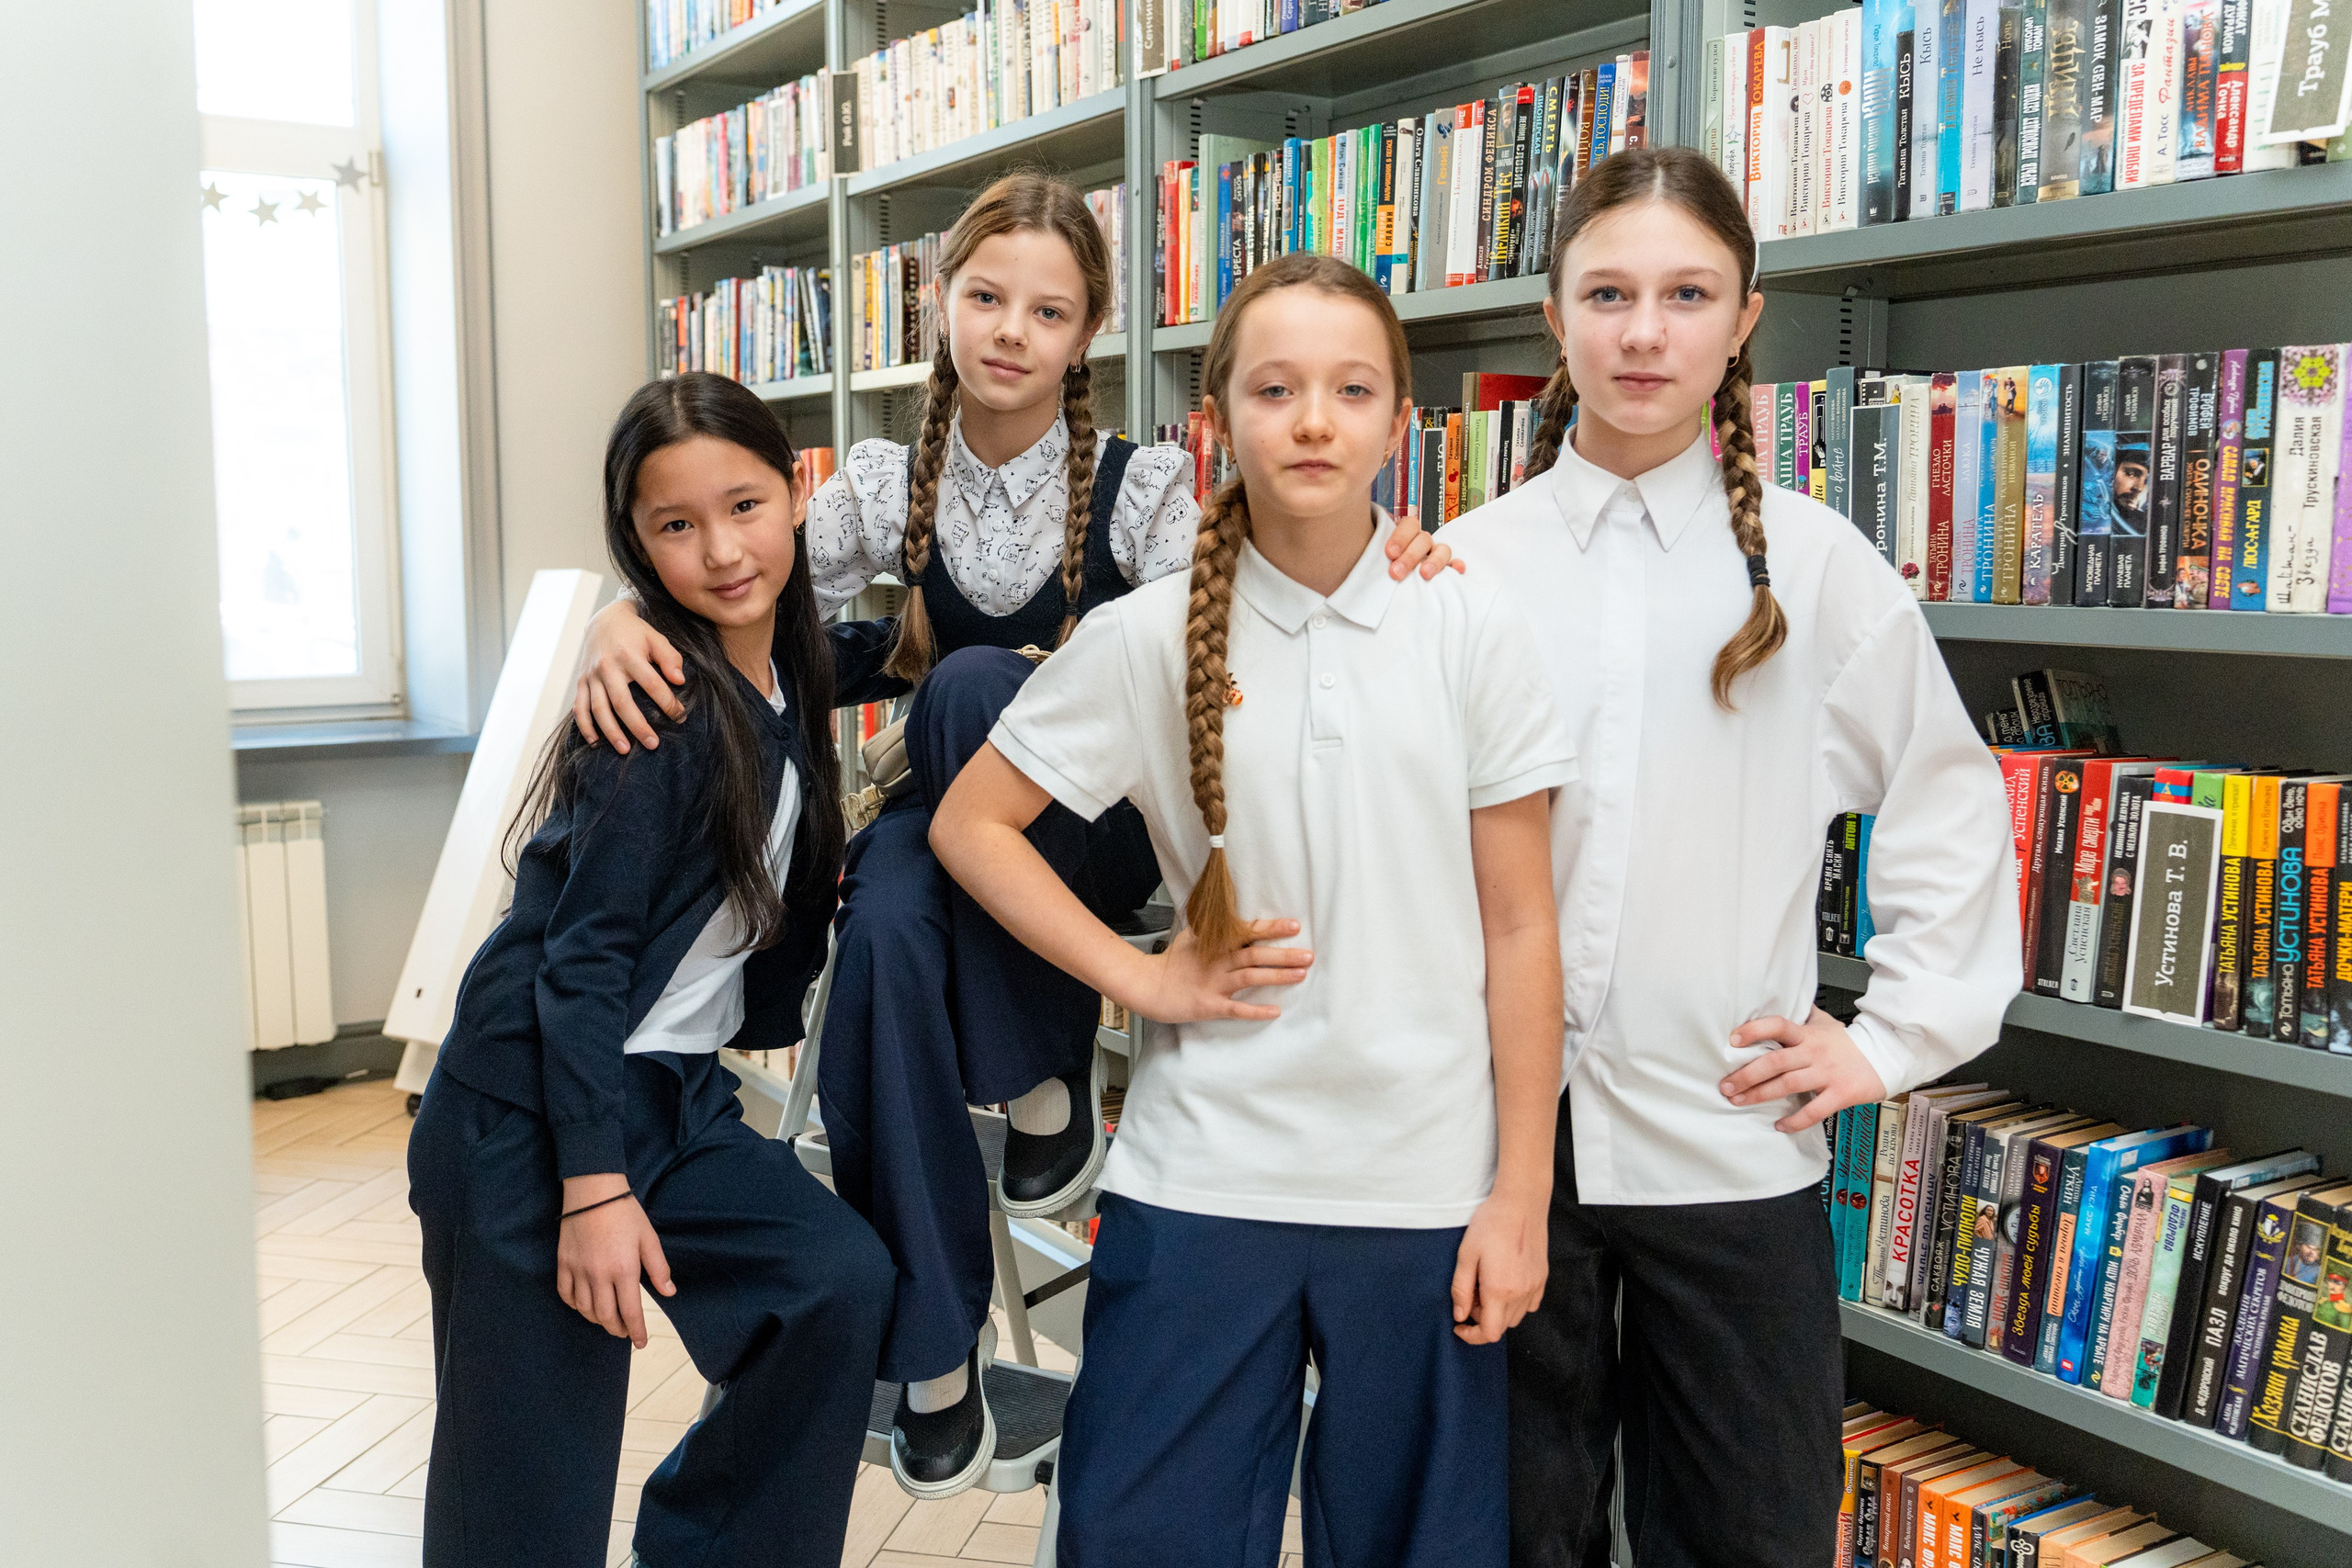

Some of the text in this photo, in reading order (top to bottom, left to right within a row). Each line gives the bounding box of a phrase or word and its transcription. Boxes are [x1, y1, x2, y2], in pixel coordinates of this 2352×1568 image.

[1920, 27, 1932, 66] Кысь
[1973, 16, 1984, 76] Не кысь
[2001, 20, 2012, 50] Ночь
[2222, 5, 2237, 54] ДУРАКОВ
[1751, 40, 1765, 110] ТОКАРЕВА
[2090, 15, 2108, 123] ЗАМОК СЕН-МАР
[2195, 12, 2215, 148] ВАДИМА ПАНОВА
[2298, 24, 2330, 97] Трауб
[1533, 96, 1544, 154] ПИОНЕРСКАЯ
[1545, 85, 1558, 153] СМЕРТЬ
[1596, 87, 1610, 136] ГОСПОДИ!
[1898, 53, 1911, 187] Татьяна Толстая КЫСЬ
[2126, 63, 2145, 184] ЗА ПРЕДЕЛАМИ ЛЮБВИ
[2158, 114, 2169, 141] Тосс
[2217, 84, 2230, 120] Точка
[2225, 80, 2245, 148] Александар
[1801, 111, 1814, 213] Виктория Токарева
[1822, 107, 1833, 208] Виктория Токарева
[1838, 102, 1849, 205] Виктория Токарева
[2020, 84, 2041, 187] ВЗРЫВ СЕГОДНЯ
[1413, 160, 1422, 217] Славникова
[1437, 145, 1449, 185] Гений
[1482, 108, 1498, 221] СИНДРОМ ФЕНИКСА
[1514, 144, 1525, 188] СЛОВИН
[1756, 394, 1770, 448] ТРАУБ
[1781, 392, 1795, 446] ТРАУБ
[1799, 412, 1808, 457] ТРАУБ
[2063, 384, 2072, 457] ЗНАМЕНИТОСТЬ
[2188, 387, 2199, 436] ТРОФИМОВ
[2290, 416, 2305, 457] Далия
[1932, 448, 1940, 488] ГНЕЗДО
[1942, 439, 1951, 496] ЛАСТОЧКИ
[2160, 443, 2177, 480] ВАРВАР
[2303, 416, 2323, 508] Трускиновская
[2030, 494, 2044, 569] КАРАТЕЛЬ
[2192, 459, 2211, 550] ОДИНОЧКА
[2214, 446, 2238, 599] САМАЯ КРАСИВАЯ НА СВЕТЕ
[1937, 521, 1949, 577] ТРОНИНА
[1962, 518, 1975, 574] ТРОНИНА
[1982, 503, 1995, 581] ТРОНИНА
[2003, 503, 2016, 582] ТРОНИНА
[2086, 545, 2095, 592] ЗАПОВЕДНАЯ
[2094, 552, 2102, 585] ПЛАНЕТА
[2124, 555, 2132, 588] ПЛАНЕТА
[2014, 768, 2031, 840] УСПЕНСКИЙ
[2054, 794, 2068, 855] Михаил Успенский
[2130, 795, 2142, 818] ЗОЛОТА
[2281, 786, 2296, 833] Один день,
[2295, 786, 2305, 829] одна ночь
[2032, 842, 2044, 874] Другая,
[2075, 847, 2102, 874] Море
[2081, 817, 2104, 850] смерти
[1825, 840, 1835, 892] ВРЕМЯ СНЯТЬ
[1832, 853, 1842, 880] МАСКИ
[2068, 905, 2083, 956] Светлана
[2075, 907, 2091, 964] Успенская
[2154, 840, 2188, 987] Устинова Т. В.
[2219, 858, 2242, 974] ТАТЬЯНА УСТИНОВА
[2252, 860, 2274, 978] ТАТЬЯНА УСТИНОВА
[2306, 868, 2329, 989] ТАТЬЯНА УСТИНОВА
[2278, 964, 2294, 1019] Татьяна
[1851, 1105, 1875, 1184] Устинова
[1880, 1130, 1889, 1157] Родня
[1892, 1159, 1920, 1262] КРАСОТКА
[1941, 1155, 1963, 1233] УСТИНОВА
[2064, 1165, 2080, 1204] УТКИН
[1872, 1195, 1890, 1285] Татьяна Устинова
[1952, 1195, 1977, 1287] ЧУДО-ПИЛЮЛИ
[2085, 1211, 2094, 1236] МАКС
[2163, 1203, 2180, 1252] ФЕДОРОВА
[2192, 1201, 2212, 1261] ИСКУПЛЕНИЕ
[1931, 1240, 1945, 1292] САКВОЯЖ
[1966, 1247, 1990, 1329] ЧУЖАЯ ЗЕМЛЯ
[2012, 1204, 2041, 1337] Звезда моей судьбы
[2126, 1258, 2141, 1280] ДОЧЬ
[2205, 1205, 2243, 1347] ПАЗЛ вокруг да около кино
[2093, 1260, 2120, 1366] ИЩУ КВАРТИРУ НА АРБАТЕ
[2233, 1294, 2250, 1347] АКАДЕМИЯ
[2236, 1268, 2267, 1380] МАГИЧЕСКИХ СЕКРЕТОВ
[2252, 1370, 2287, 1427] Хозяин
[2271, 1315, 2300, 1371] урмана
[2290, 1331, 2328, 1438] СТАНИСЛАВ
[2308, 1360, 2342, 1443] ФЕДОТОВ
[1845, 1458, 1854, 1494] Фомичев
[1862, 1496, 1878, 1555] Серая Орда
[1883, 1516, 1891, 1552] Янтарный
[1904, 1518, 1912, 1551] Ведьмин
[1922, 1511, 1937, 1547] МАКС
[1949, 1523, 1963, 1561] МАКС
